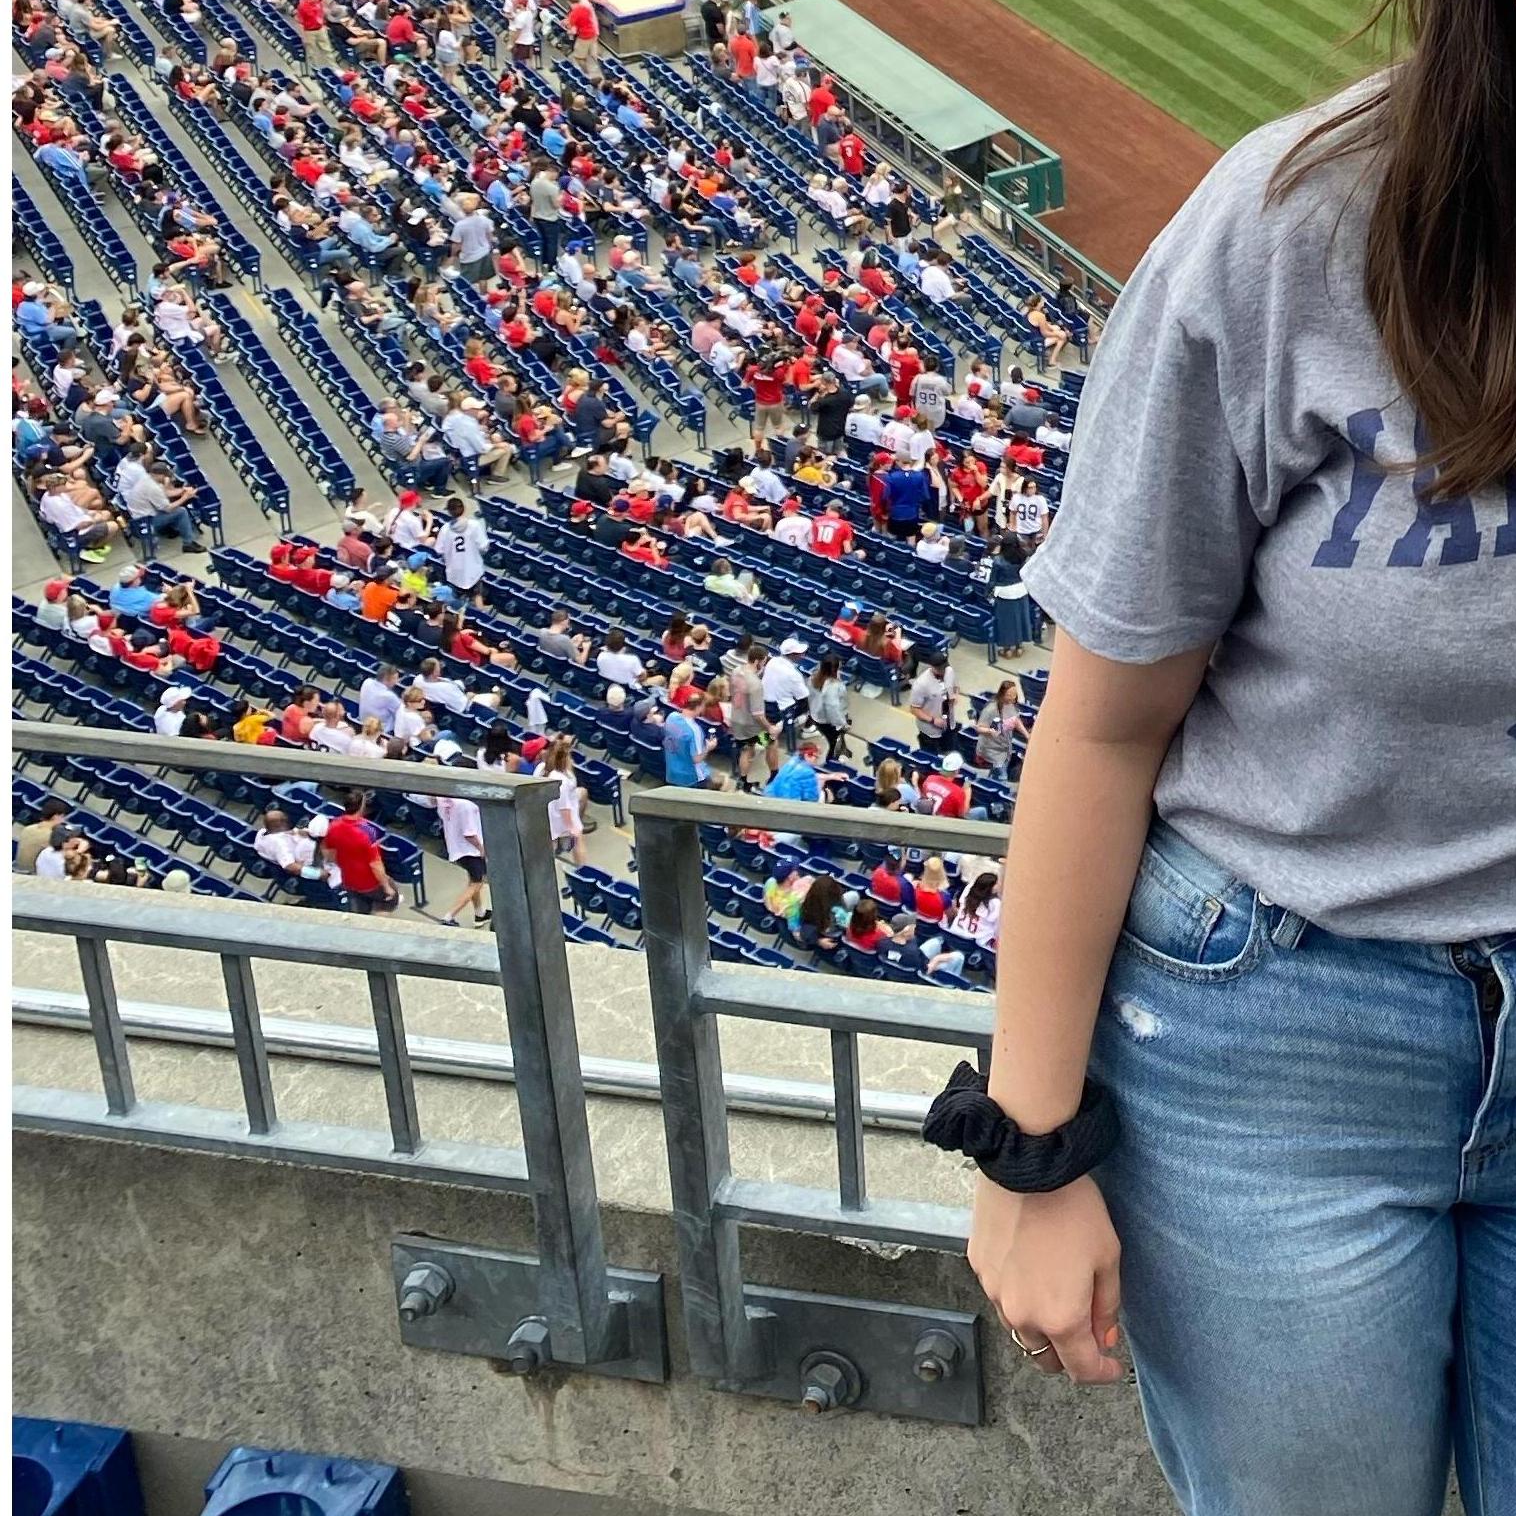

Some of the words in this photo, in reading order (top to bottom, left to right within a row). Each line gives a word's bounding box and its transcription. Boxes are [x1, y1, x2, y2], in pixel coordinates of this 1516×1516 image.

[919, 391, 938, 406] 99
[849, 422, 859, 438] 2
[1016, 502, 1038, 522] 99
[817, 525, 833, 542] 10
[454, 536, 466, 553] 2
